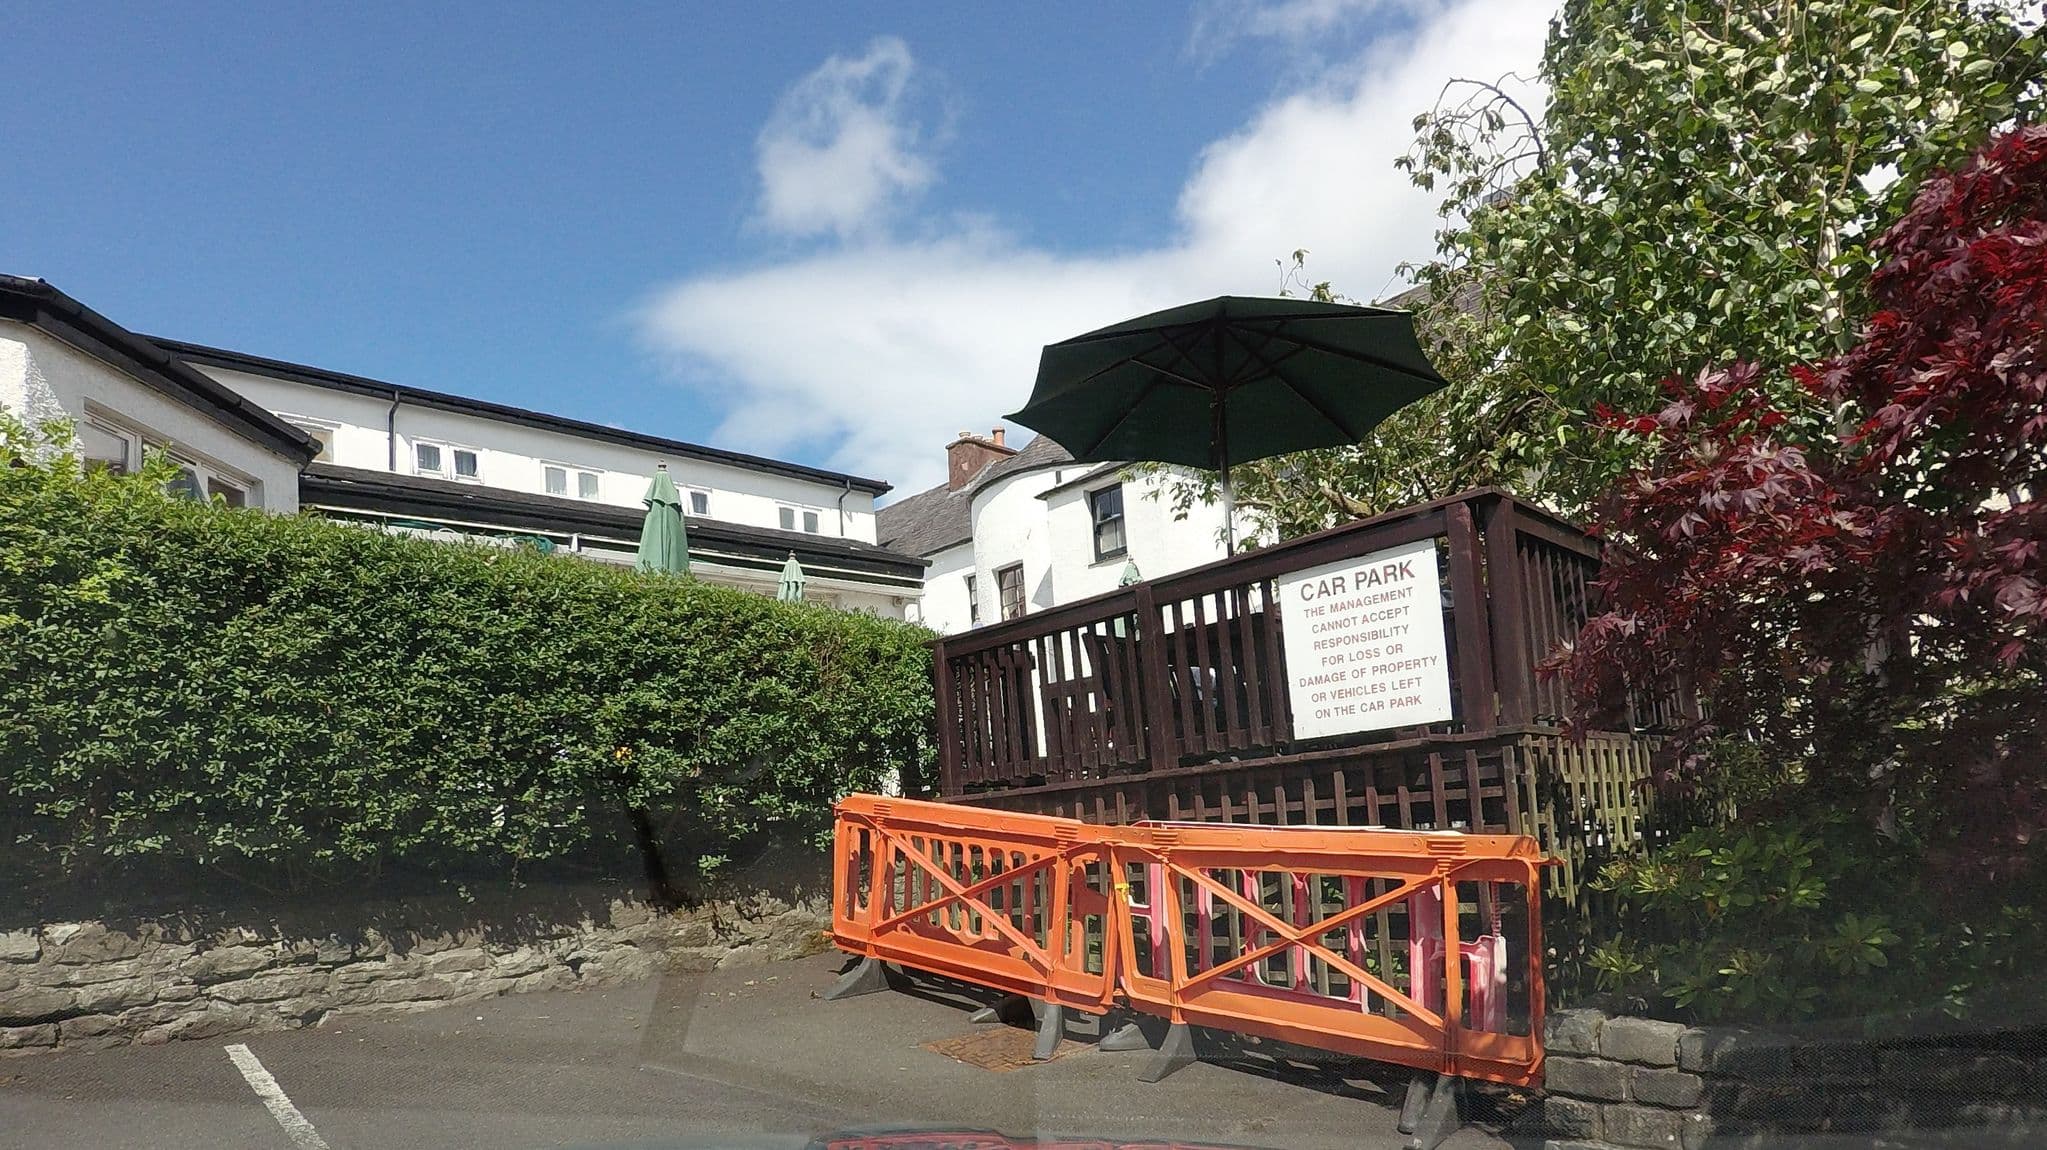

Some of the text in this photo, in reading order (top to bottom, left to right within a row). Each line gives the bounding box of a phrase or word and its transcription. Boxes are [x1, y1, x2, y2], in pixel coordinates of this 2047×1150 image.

[1301, 560, 1415, 601] CAR PARK
[1304, 587, 1413, 618] THE MANAGEMENT
[1312, 606, 1410, 633] CANNOT ACCEPT
[1314, 625, 1409, 651] RESPONSIBILITY
[1322, 644, 1403, 666] FOR LOSS OR
[1300, 656, 1437, 687] DAMAGE OF PROPERTY
[1312, 677, 1422, 703] OR VEHICLES LEFT
[1316, 695, 1422, 719] ON THE CAR PARK
